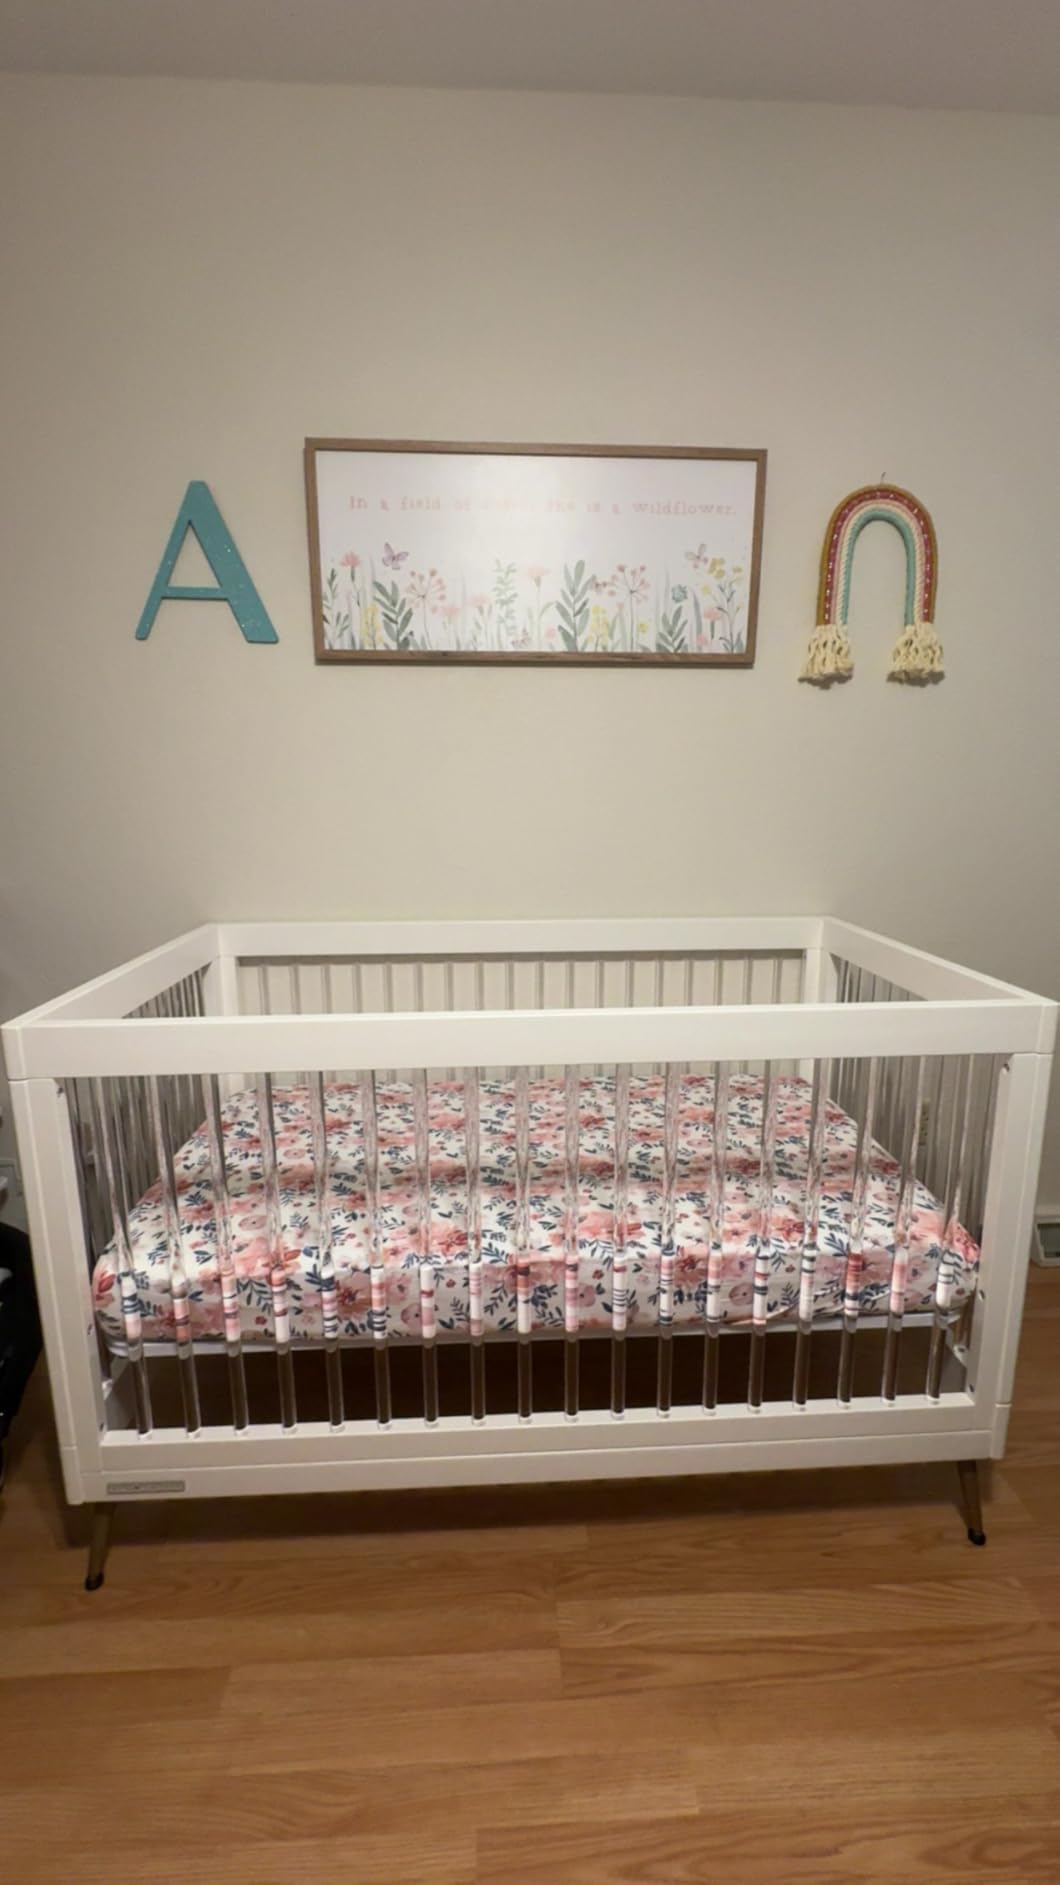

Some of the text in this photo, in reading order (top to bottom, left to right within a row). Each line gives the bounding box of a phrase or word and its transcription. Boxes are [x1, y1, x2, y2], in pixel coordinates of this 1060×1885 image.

[349, 496, 368, 511] In
[401, 496, 440, 512] field
[632, 500, 737, 515] wildflower.
[135, 480, 279, 644] A
